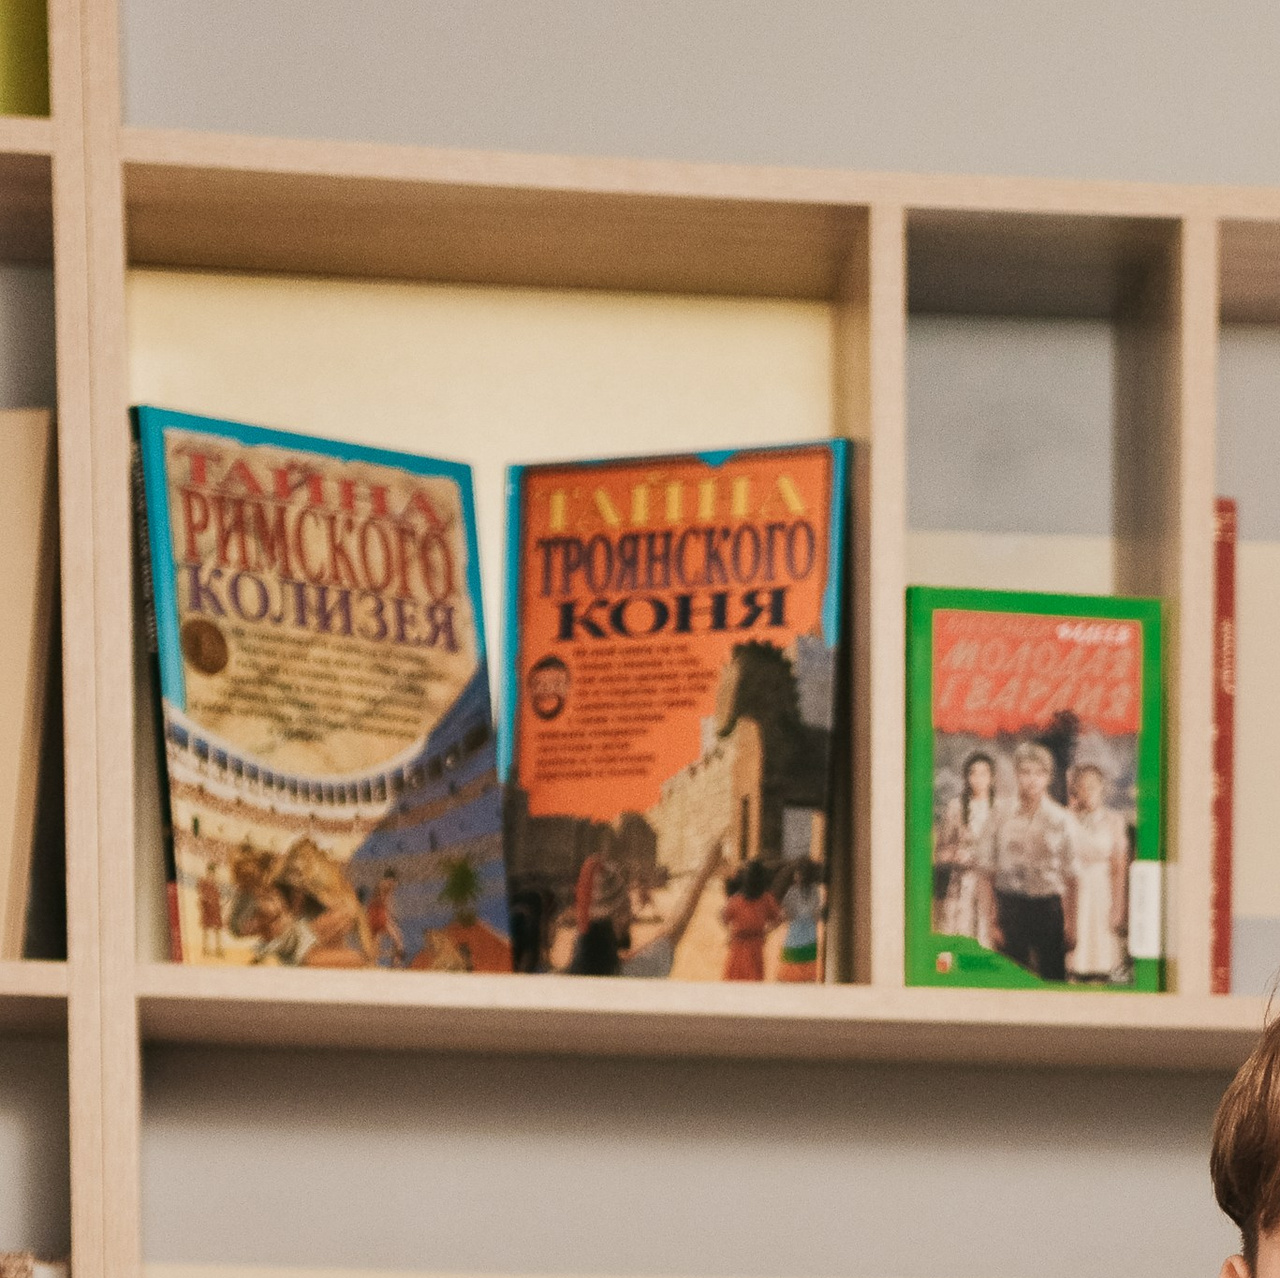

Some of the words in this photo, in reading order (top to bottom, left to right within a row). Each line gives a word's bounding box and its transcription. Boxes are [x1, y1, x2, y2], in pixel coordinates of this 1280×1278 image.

[173, 444, 456, 532] ТАЙНА
[537, 470, 806, 534] ТАЙНА
[180, 487, 459, 603] РИМСКОГО
[537, 520, 816, 598] ТРОЯНСКОГО
[183, 562, 460, 654] КОЛИЗЕЯ
[557, 587, 788, 642] КОНЯ
